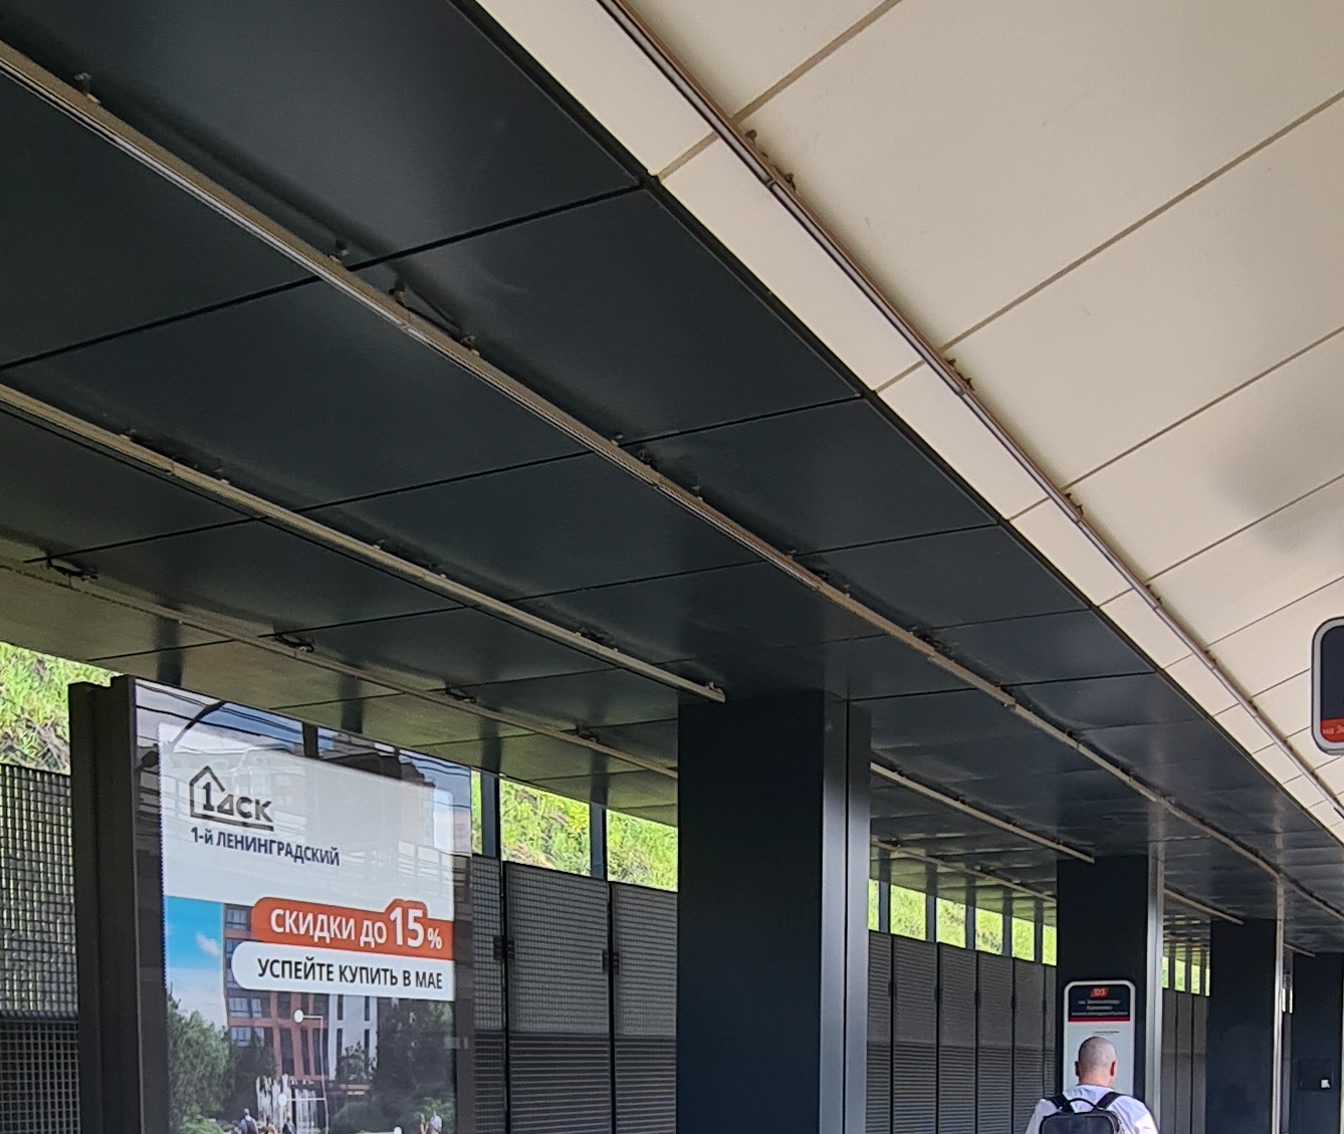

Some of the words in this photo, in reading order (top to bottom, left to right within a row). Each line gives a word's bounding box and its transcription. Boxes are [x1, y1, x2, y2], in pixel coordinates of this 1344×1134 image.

[191, 826, 214, 846] 1-й
[216, 831, 340, 867] ЛЕНИНГРАДСКИЙ
[270, 908, 356, 943] СКИДКИ
[257, 956, 335, 983] УСПЕЙТЕ
[338, 967, 399, 988] КУПИТЬ
[402, 970, 412, 988] В
[415, 972, 443, 990] МАЕ
